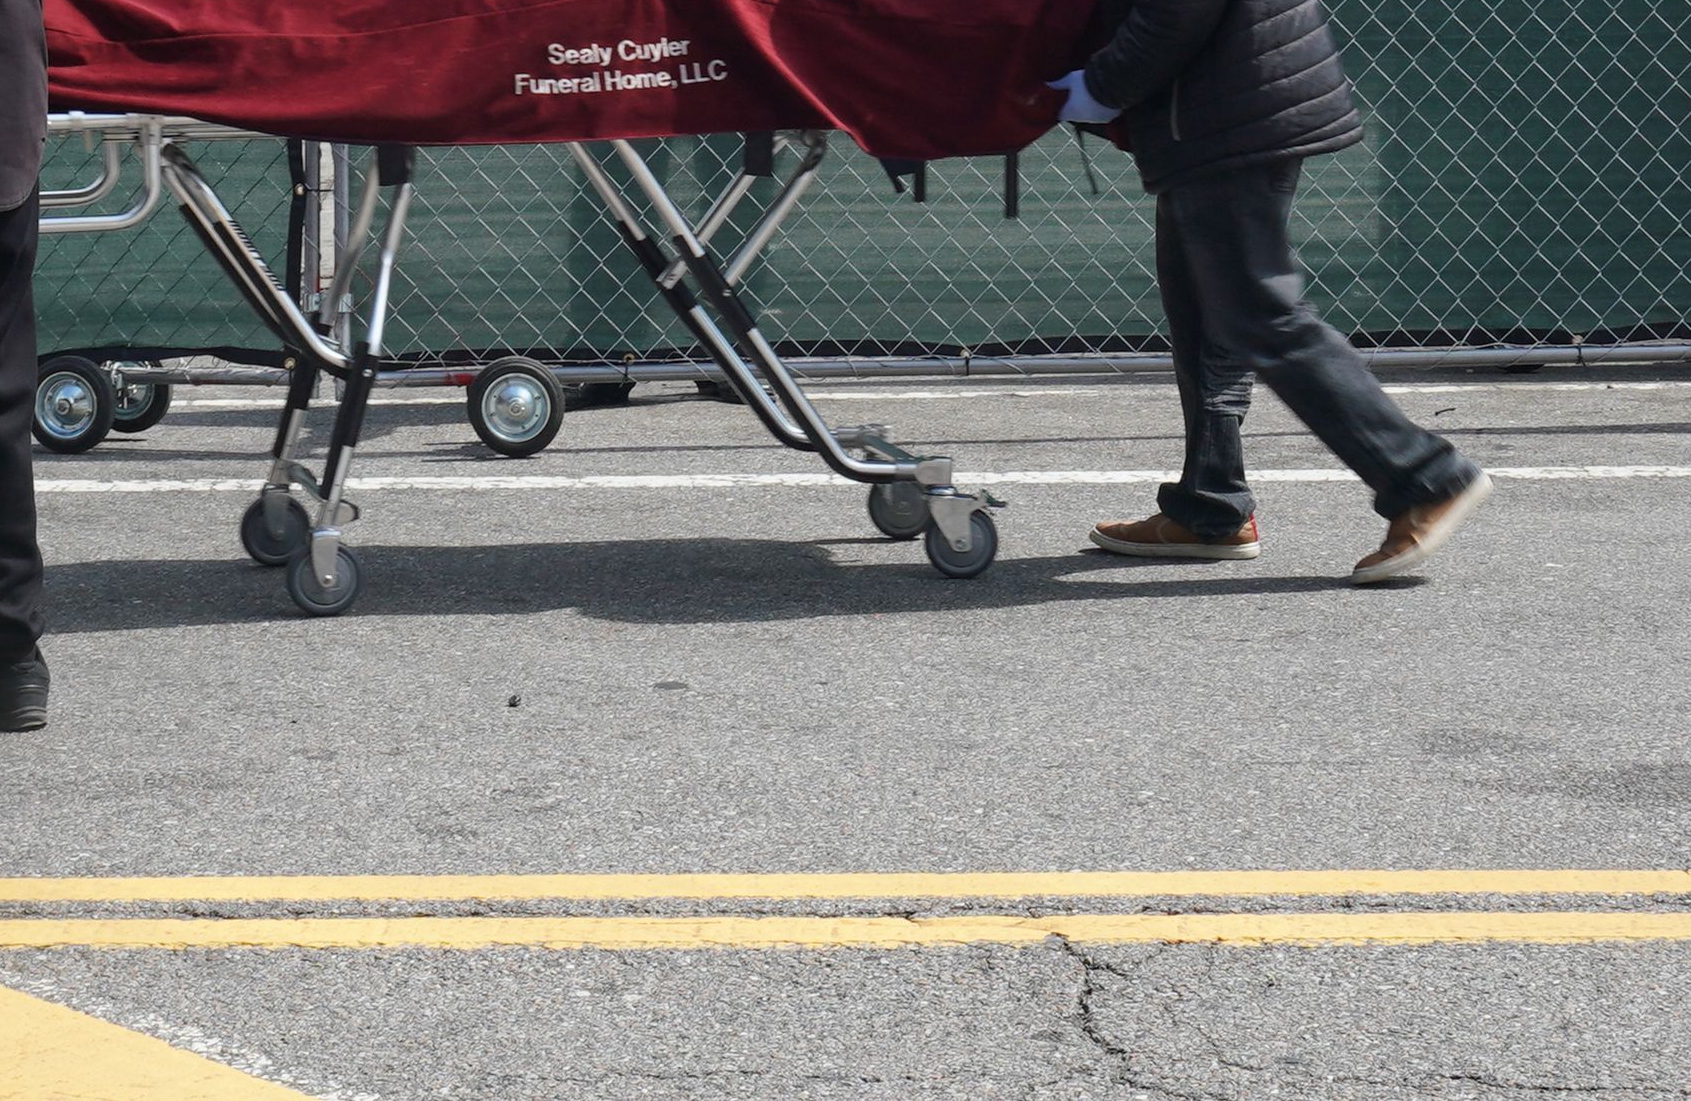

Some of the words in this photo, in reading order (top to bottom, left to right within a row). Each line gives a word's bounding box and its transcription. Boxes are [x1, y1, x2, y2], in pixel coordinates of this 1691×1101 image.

[548, 43, 612, 66] Sealy
[617, 37, 690, 62] Cuyler
[514, 72, 601, 95] Funeral
[605, 70, 678, 92] Home,
[679, 59, 728, 84] LLC
